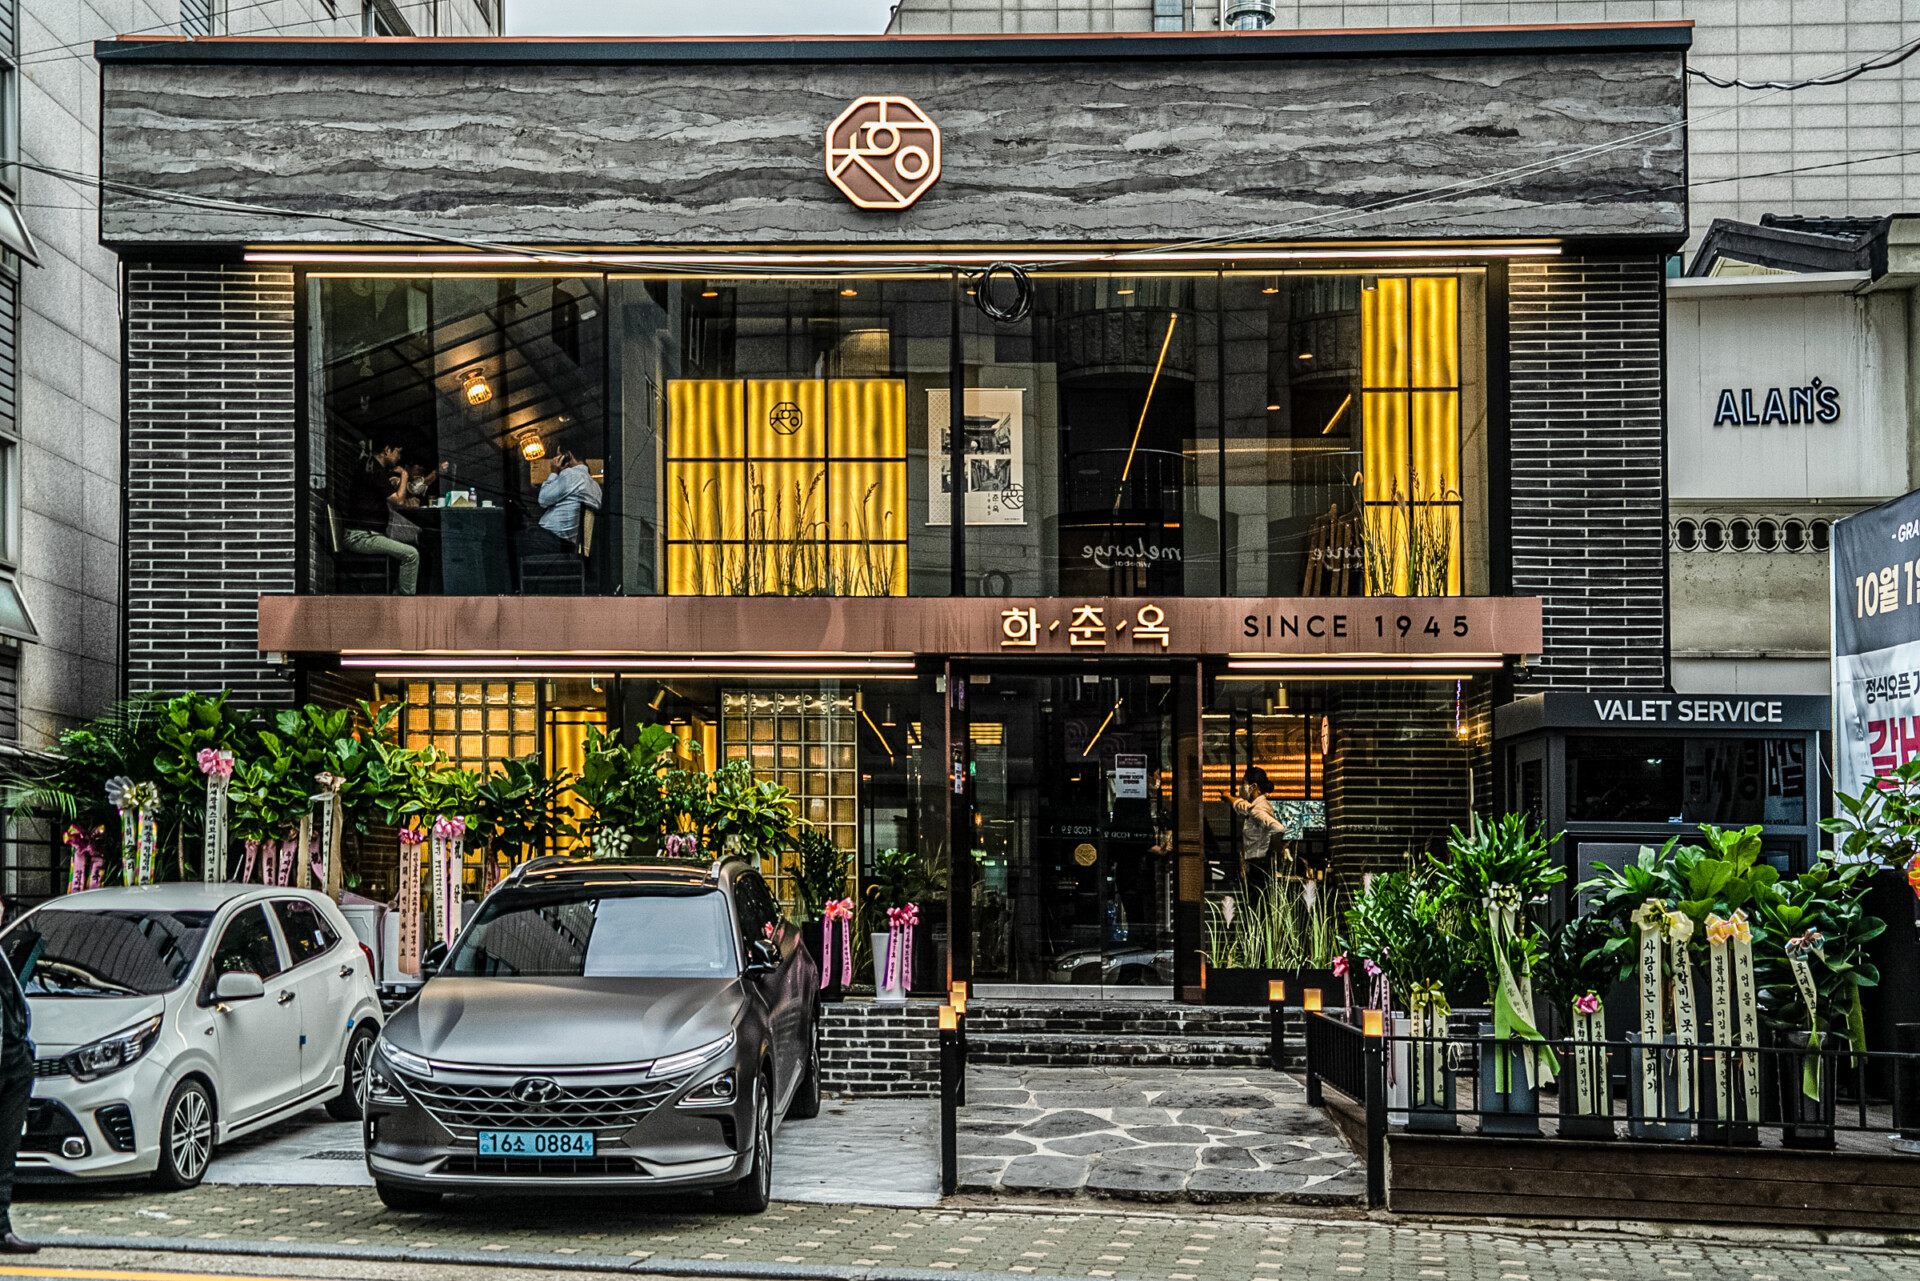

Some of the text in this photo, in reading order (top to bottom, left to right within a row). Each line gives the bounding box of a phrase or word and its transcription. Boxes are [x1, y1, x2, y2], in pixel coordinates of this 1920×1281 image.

[1855, 564, 1899, 618] 10월
[1244, 615, 1469, 637] SINCE 1945
[1866, 672, 1910, 703] 정식오픈
[1594, 700, 1783, 722] VALET SERVICE
[1643, 939, 1656, 1003] 사랑하는
[1739, 954, 1752, 1007] 개업을
[1644, 1009, 1657, 1040] 친구
[490, 1133, 585, 1153] 16소 0884
